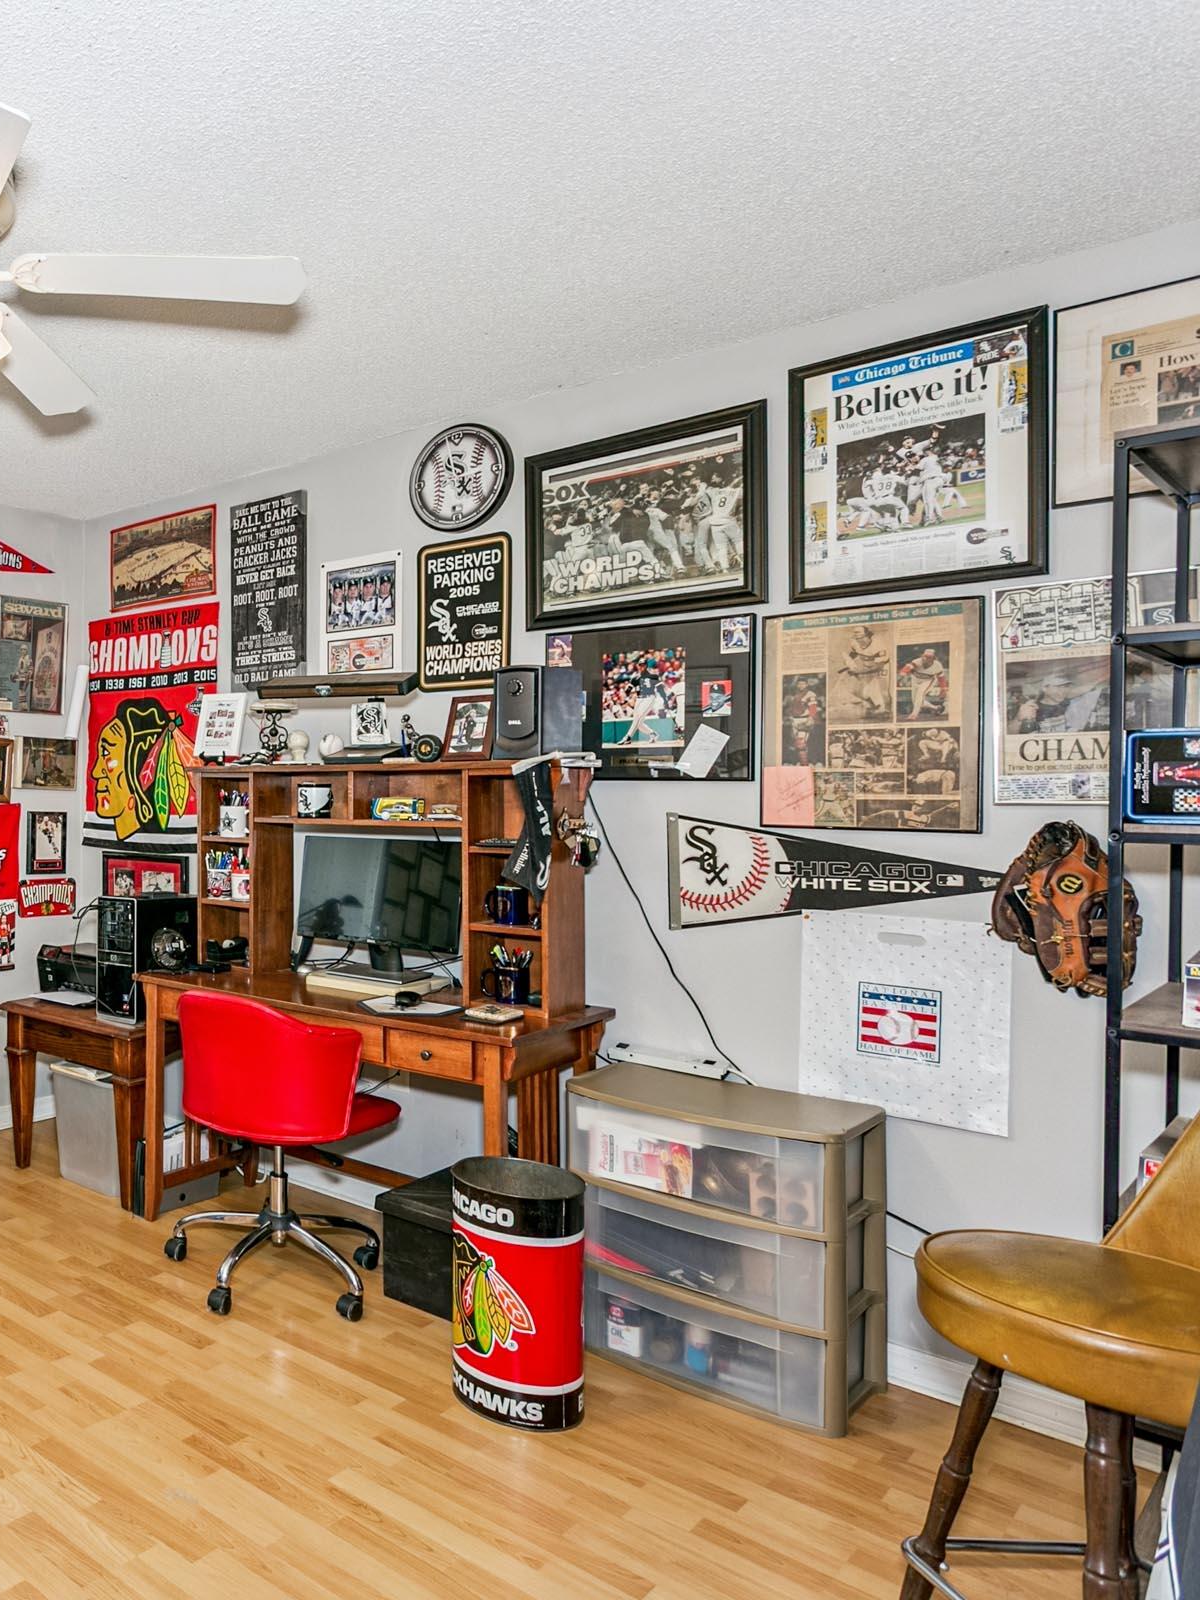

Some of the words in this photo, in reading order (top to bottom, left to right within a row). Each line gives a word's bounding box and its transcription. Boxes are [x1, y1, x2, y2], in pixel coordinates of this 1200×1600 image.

[854, 364, 906, 382] Chicago
[908, 349, 964, 369] Tribune
[1160, 354, 1195, 367] How
[833, 381, 944, 422] Believe
[954, 365, 988, 396] it!
[838, 420, 860, 431] White
[897, 408, 920, 419] World
[922, 402, 945, 412] Series
[862, 424, 890, 435] Chicago
[892, 419, 908, 428] with
[543, 481, 588, 504] SOX
[877, 480, 893, 492] 38
[236, 508, 249, 517] TAKE
[260, 502, 270, 511] OUT
[272, 500, 279, 508] TO
[280, 497, 292, 506] THE
[718, 497, 728, 507] 8
[233, 514, 261, 530] BALL
[265, 504, 298, 523] GAME
[236, 535, 253, 544] WITH
[255, 531, 267, 539] THE
[270, 525, 296, 537] CROWD
[238, 527, 257, 535] TAKE
[275, 519, 291, 527] OUT
[579, 524, 593, 537] 33
[234, 540, 275, 556] PEANUTS
[278, 535, 297, 547] AND
[234, 552, 269, 569] CRACKER
[271, 546, 297, 561] JACKS
[428, 549, 501, 574] RESERVED
[559, 549, 643, 576] WORLD
[236, 572, 259, 585] NEVER
[260, 569, 275, 581] GET
[276, 564, 296, 578] BACK
[434, 566, 495, 589] PARKING
[553, 563, 661, 594] CHAMPS!
[279, 584, 299, 599] ROOT
[449, 585, 480, 598] 2005
[4, 602, 64, 618] savard
[456, 601, 499, 611] CHICAGO
[456, 609, 481, 617] WHITE
[114, 621, 135, 635] TIME
[138, 612, 178, 631] STANLEY
[182, 609, 200, 625] CUP
[830, 616, 847, 625] The
[849, 614, 870, 623] year
[873, 612, 889, 620] the
[892, 610, 909, 618] Sox
[90, 625, 218, 674] CHAMPIONS
[235, 654, 260, 666] THREE
[262, 650, 296, 663] STRIKES
[426, 643, 463, 661] WORLD
[464, 639, 502, 656] SERIES
[425, 655, 501, 676] CHAMPIONS
[105, 679, 124, 690] 1938
[129, 677, 146, 689] 1961
[151, 675, 168, 686] 2010
[173, 673, 188, 683] 2013
[194, 669, 217, 681] 2015
[235, 673, 249, 684] OLD
[251, 671, 269, 682] BALL
[1019, 738, 1109, 762] CHAM
[774, 861, 933, 879] CHICAGO
[776, 875, 862, 892] WHITE
[868, 878, 931, 894] SOX
[863, 984, 937, 998] NATIONAL
[860, 1043, 887, 1052] HALL
[906, 1049, 935, 1059] FAME
[453, 1186, 514, 1228] HICAGO
[610, 1327, 624, 1340] OIL
